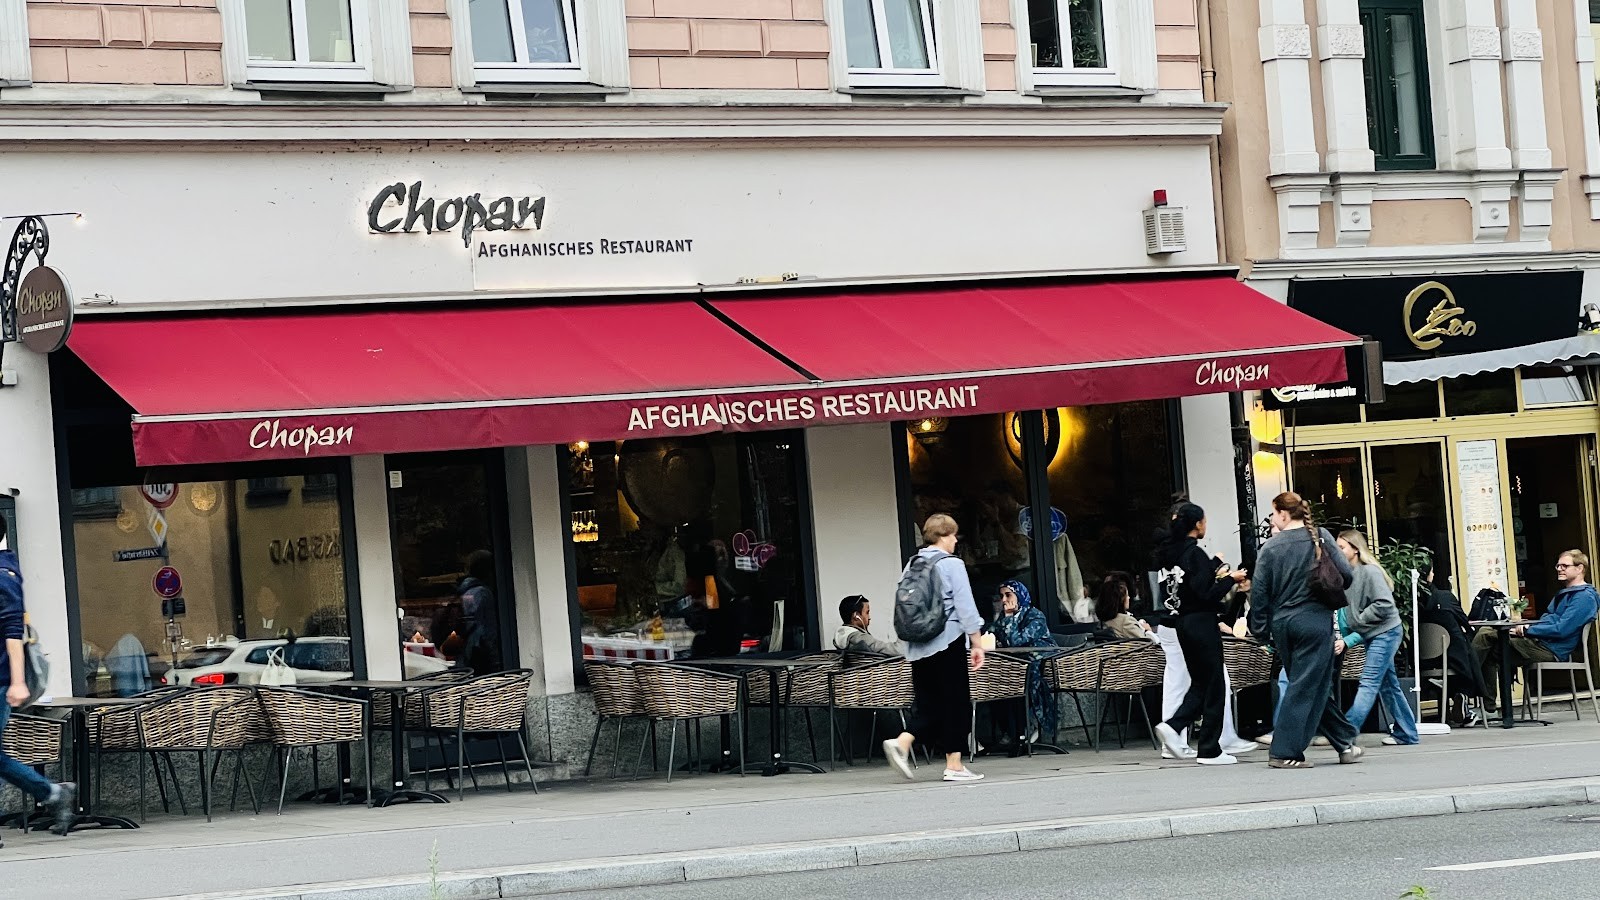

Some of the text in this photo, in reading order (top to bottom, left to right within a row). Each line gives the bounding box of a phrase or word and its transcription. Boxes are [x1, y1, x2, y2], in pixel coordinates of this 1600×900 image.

[367, 180, 546, 248] Chopan
[20, 286, 62, 320] Chopan
[1195, 360, 1269, 389] Chopan
[822, 385, 979, 417] RESTAURANT
[249, 419, 353, 456] Chopan
